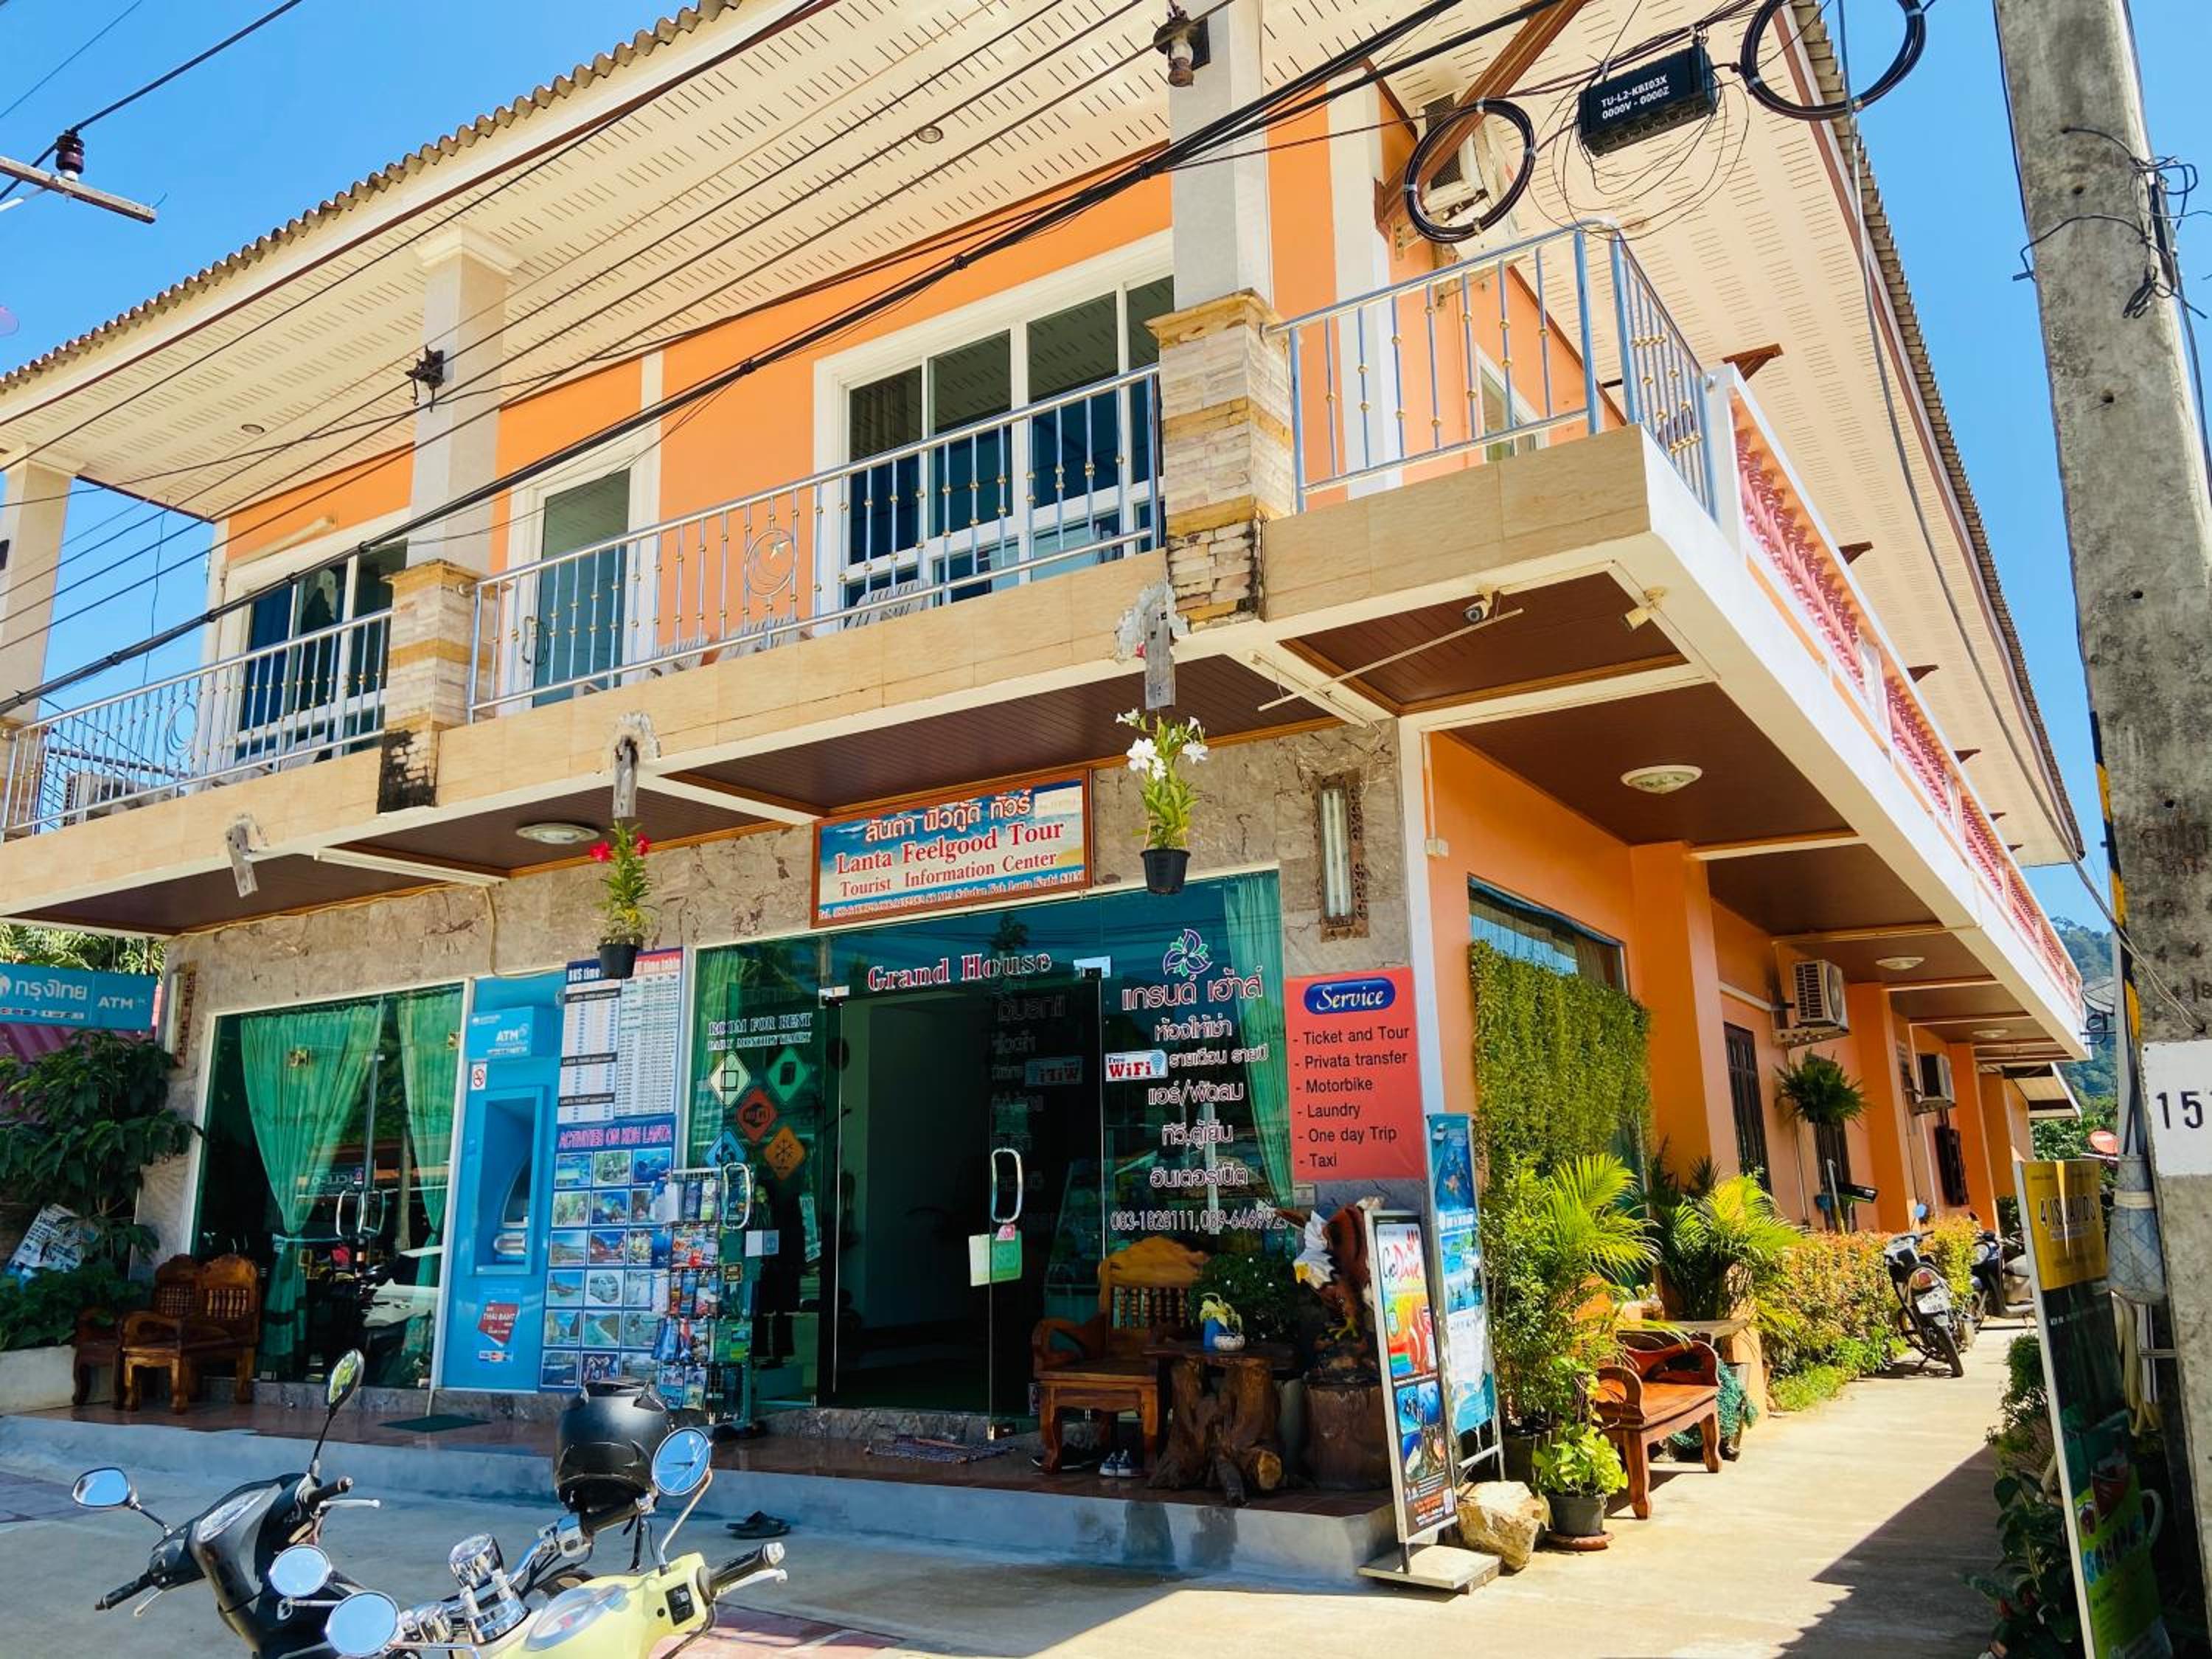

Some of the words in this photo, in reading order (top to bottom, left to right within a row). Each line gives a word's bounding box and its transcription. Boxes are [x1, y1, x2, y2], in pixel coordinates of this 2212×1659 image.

[835, 849, 892, 875] Lanta
[902, 830, 998, 864] Feelgood
[1007, 823, 1064, 846] Tour
[841, 877, 891, 898] Tourist
[905, 860, 995, 888] Information
[1003, 852, 1057, 872] Center
[868, 958, 950, 992] Grand
[961, 953, 1052, 981] House
[14, 978, 87, 1002] กรุงไทย
[1121, 974, 1197, 1011] แกรนด์
[1316, 984, 1384, 1012] Service
[97, 996, 133, 1010] ATM
[750, 1015, 776, 1032] FOR
[778, 1012, 813, 1029] RENT
[1154, 1012, 1232, 1042] ห้องให้เช่า
[495, 1029, 519, 1042] ATM
[1303, 1031, 1343, 1046] Ticket
[1348, 1029, 1373, 1043] and
[1377, 1026, 1410, 1040] Tour
[1169, 1046, 1228, 1068] รายเดือน
[1354, 1051, 1408, 1066] transfer
[1108, 1061, 1152, 1077] WiFi
[1147, 1079, 1245, 1107] แอร์/พัดลม
[1306, 1078, 1373, 1093] Motorbike
[1307, 1104, 1360, 1119] Laundry
[2156, 1091, 2212, 1130] 15
[1309, 1128, 1335, 1143] One
[1340, 1127, 1365, 1144] day
[1369, 1127, 1397, 1143] Trip
[1310, 1153, 1338, 1168] Taxi
[1150, 1161, 1249, 1189] อินเตอร์เน็ต
